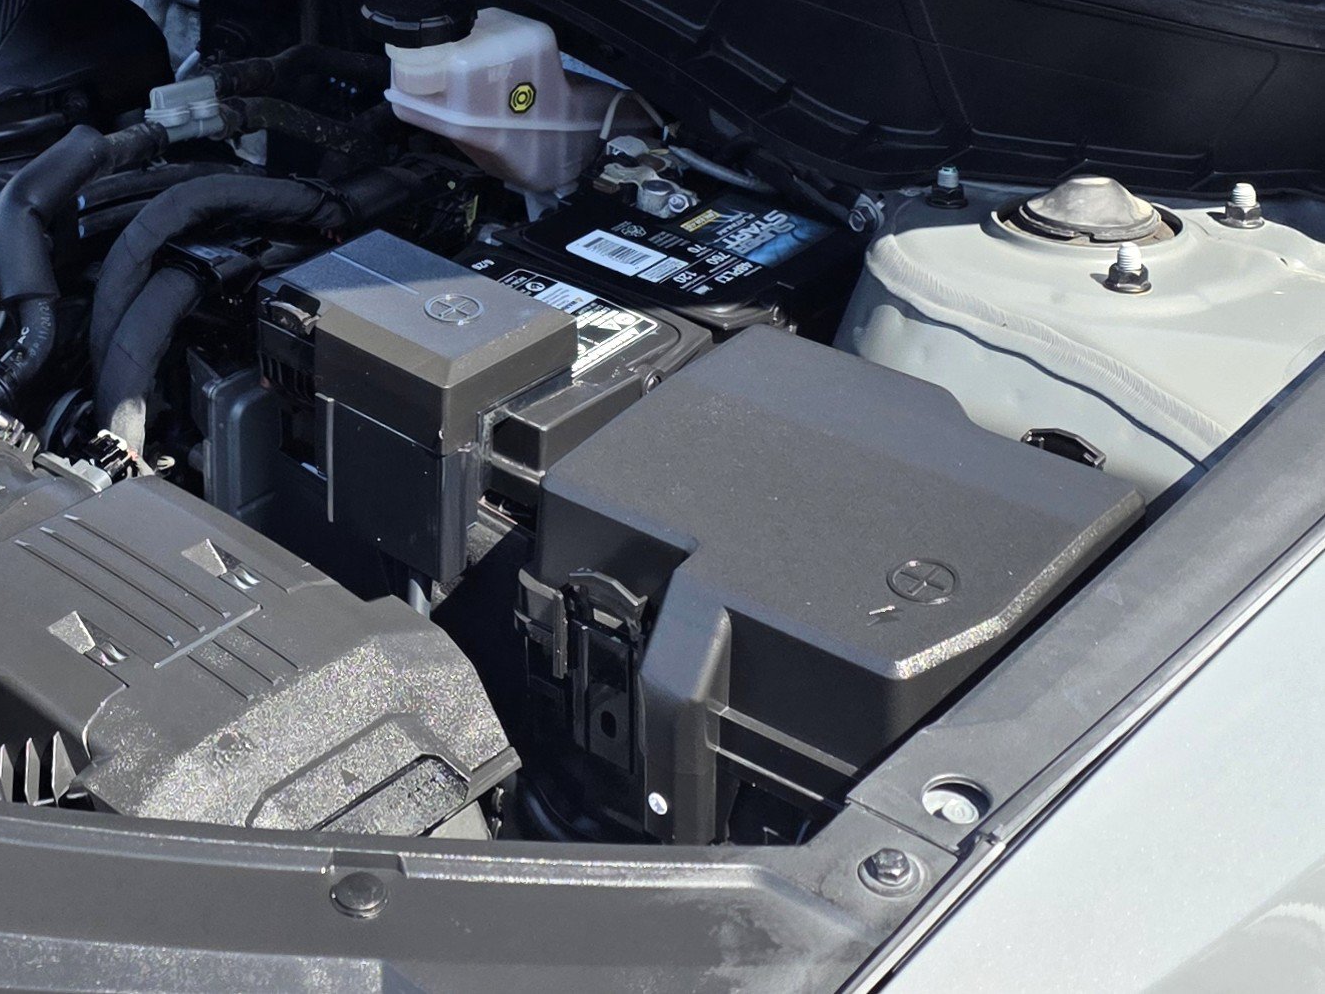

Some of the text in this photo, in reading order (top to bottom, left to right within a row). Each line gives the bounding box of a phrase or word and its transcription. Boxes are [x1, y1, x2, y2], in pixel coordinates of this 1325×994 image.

[722, 209, 789, 250] START
[735, 221, 796, 256] SUPER
[705, 252, 731, 266] 760
[673, 270, 697, 284] 120
